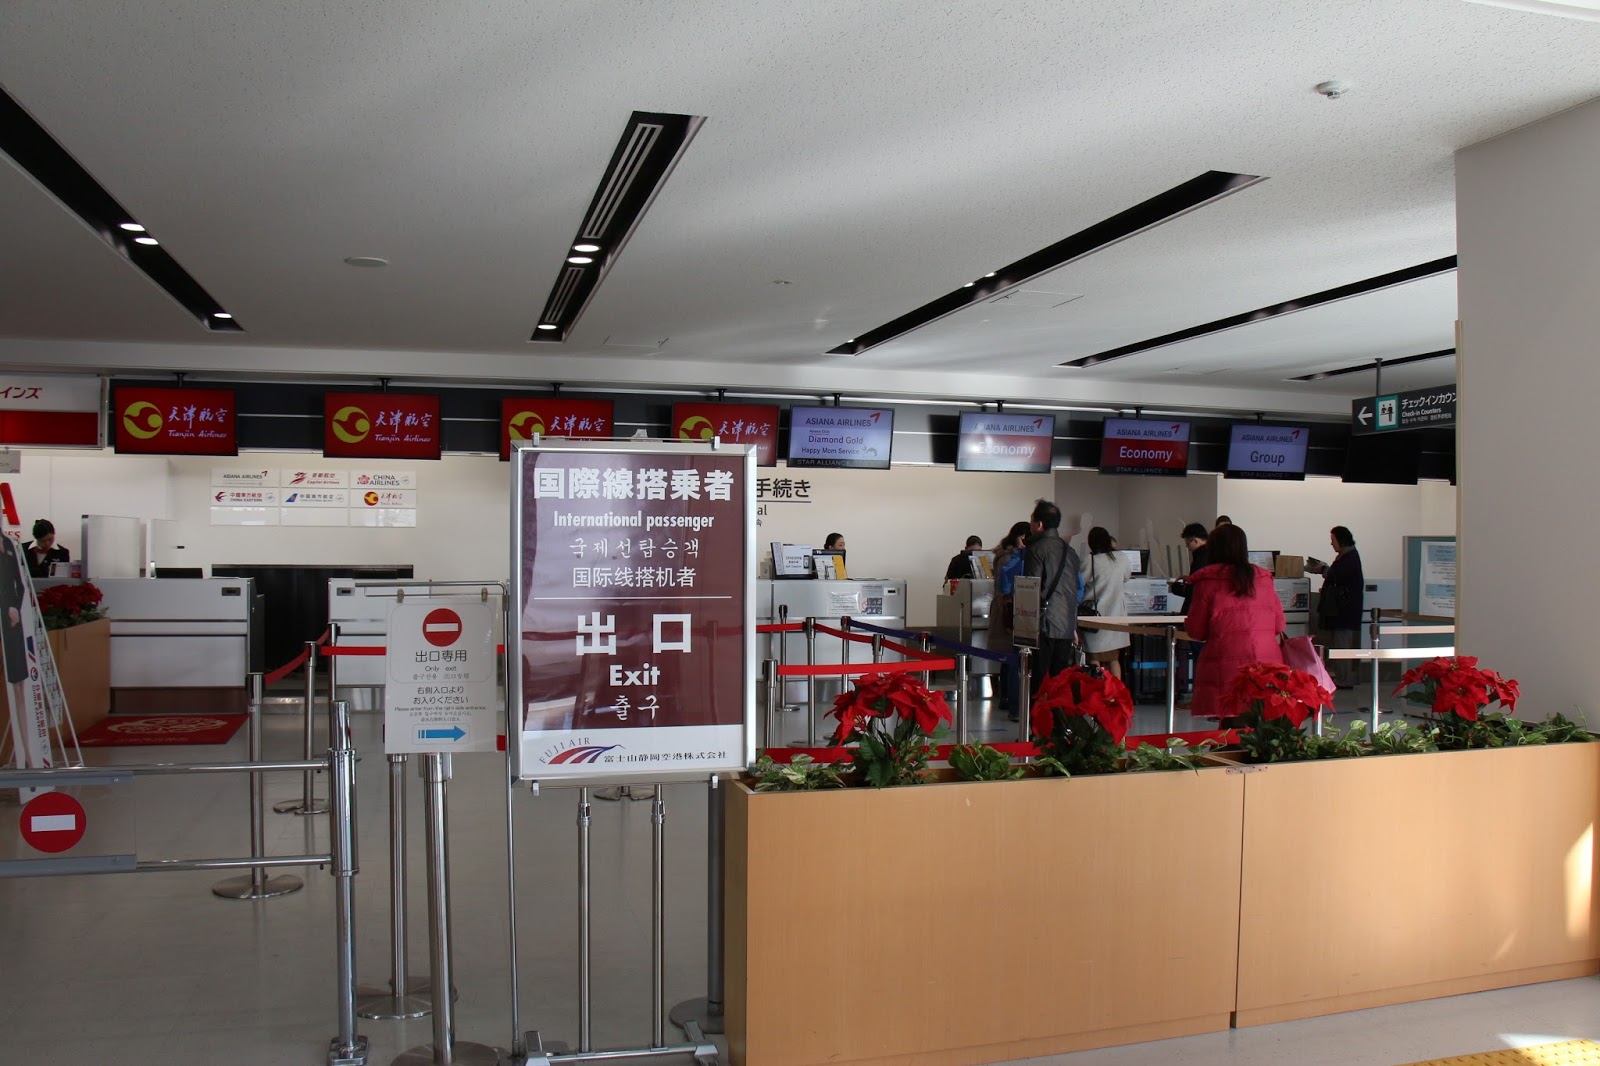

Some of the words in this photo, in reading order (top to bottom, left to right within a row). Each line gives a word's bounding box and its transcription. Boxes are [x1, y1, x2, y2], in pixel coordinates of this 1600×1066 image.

[168, 404, 228, 429] 天津航空
[1401, 410, 1420, 418] Check-in
[1420, 408, 1441, 416] Counters
[374, 409, 433, 434] 天津航空
[550, 414, 605, 437] 天津航空
[805, 417, 835, 426] ASIANA
[837, 418, 872, 427] AIRLINES
[974, 423, 1001, 432] ASIANA
[1002, 424, 1035, 433] AIRLINES
[168, 429, 195, 439] Tianjin
[198, 429, 228, 438] Airlines
[718, 418, 771, 442] 天津航空
[1116, 428, 1141, 436] ASIANA
[1143, 429, 1173, 438] AIRLINES
[374, 434, 400, 443] Tianjin
[403, 434, 431, 443] Airlines
[808, 435, 844, 444] Diamond
[846, 436, 864, 445] Gold
[1241, 434, 1264, 442] ASIANA
[1266, 435, 1294, 443] AIRLINES
[801, 446, 820, 455] Happy
[838, 447, 860, 455] Service
[978, 441, 1036, 459] Economy
[1119, 446, 1173, 462] Economy
[1250, 450, 1286, 466] Group
[534, 467, 734, 501] 国際線搭乗者
[757, 478, 811, 499] 手続き
[554, 510, 642, 527] International
[646, 515, 714, 531] passenger
[569, 537, 700, 559] 국제선탑승객
[573, 567, 696, 588] 国际线搭机者
[576, 612, 692, 655] 出口
[415, 650, 467, 663] 出口専用
[609, 663, 661, 686] Exit
[417, 686, 465, 695] 右側入口より
[412, 696, 469, 705] お入りください
[613, 695, 660, 721] 출구
[568, 737, 591, 747] AIR
[604, 751, 728, 763] 富士山静岡空港株式会社
